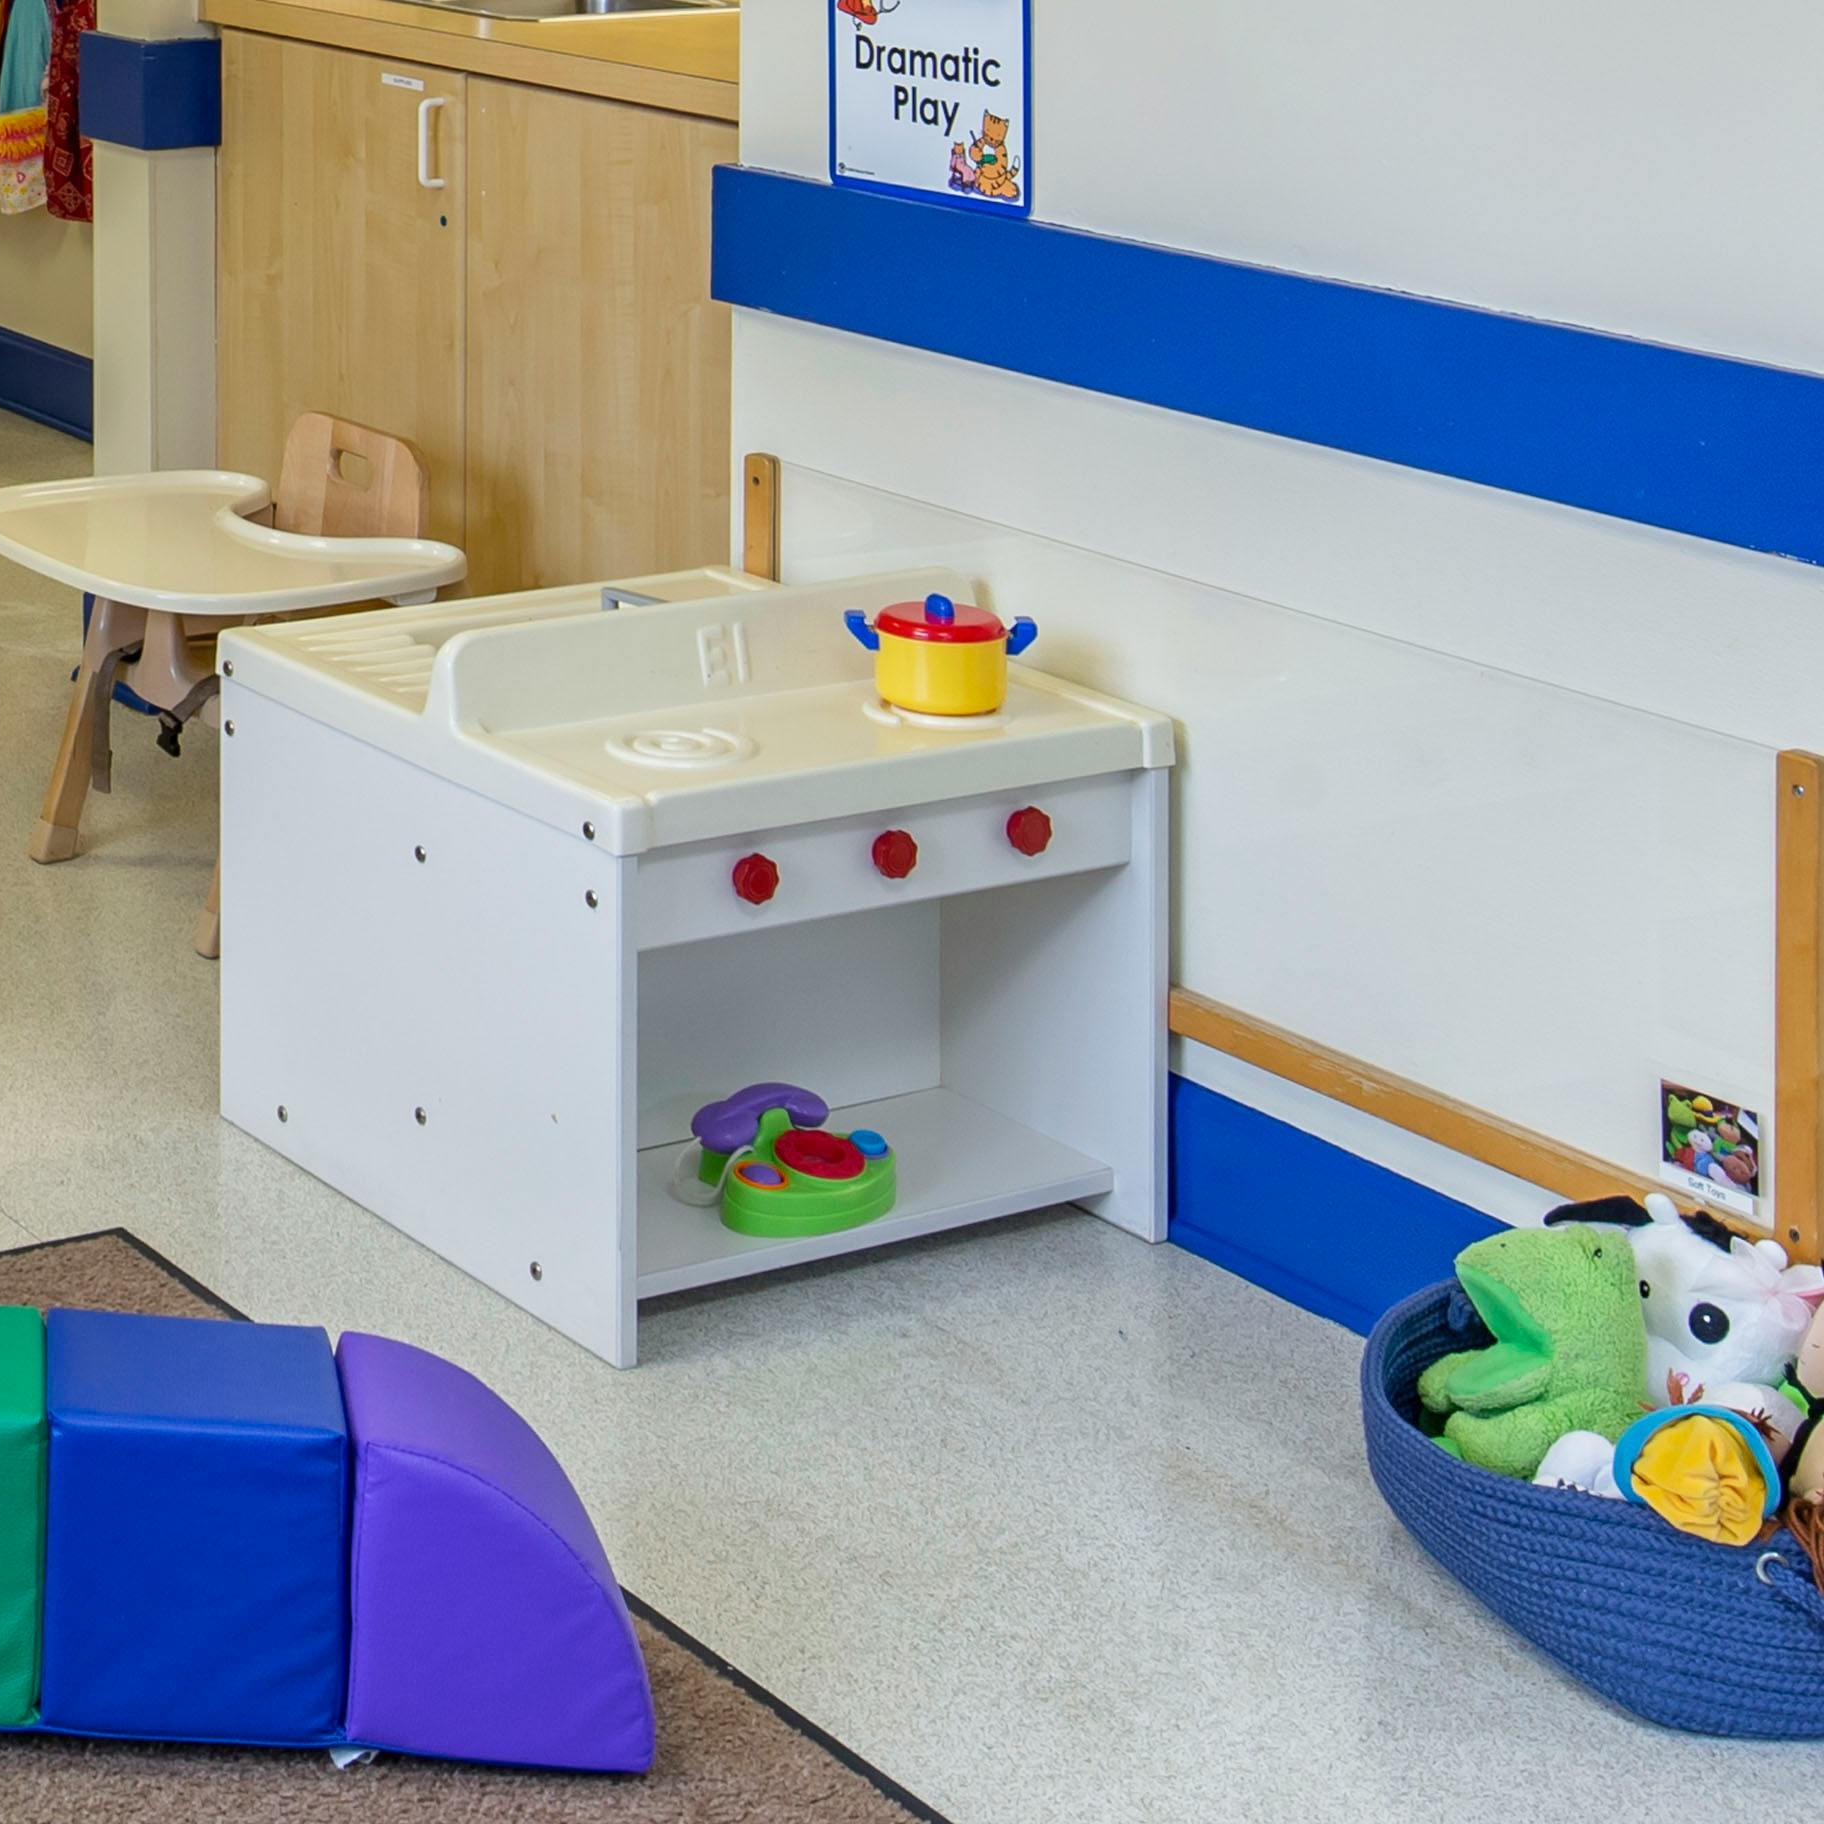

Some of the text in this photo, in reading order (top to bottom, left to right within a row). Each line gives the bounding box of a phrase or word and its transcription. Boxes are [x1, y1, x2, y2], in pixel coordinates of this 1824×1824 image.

[854, 34, 1001, 87] Dramatic
[893, 85, 960, 137] Play
[1687, 1176, 1727, 1200] Soft Toys
